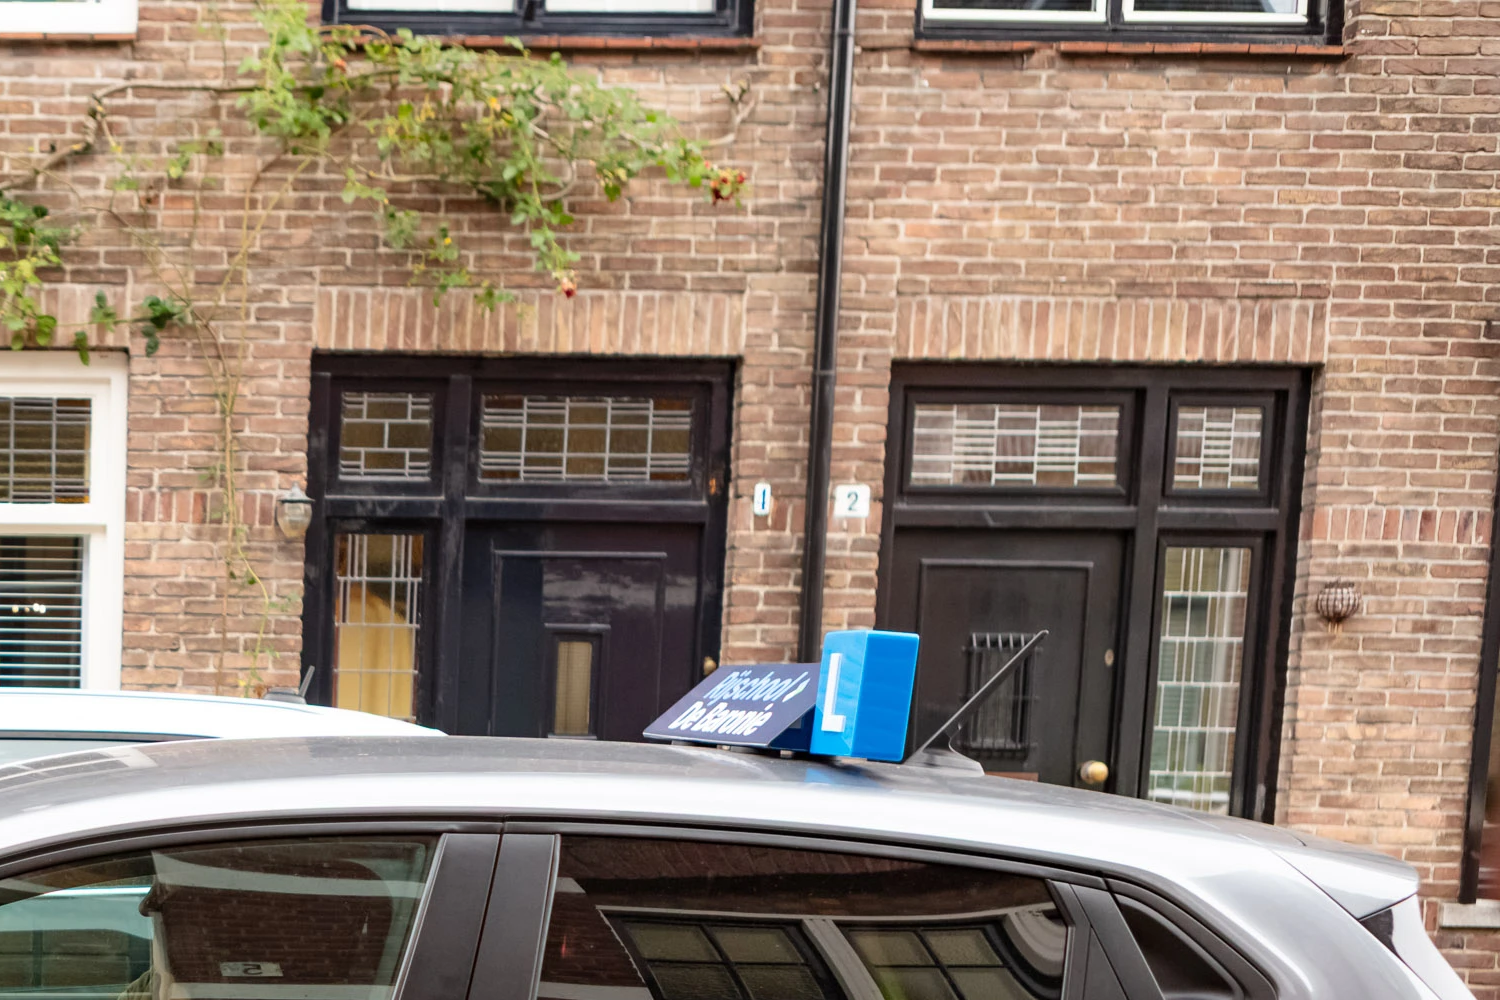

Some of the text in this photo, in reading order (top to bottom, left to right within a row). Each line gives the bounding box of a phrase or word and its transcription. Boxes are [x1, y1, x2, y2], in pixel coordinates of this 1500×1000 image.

[847, 491, 859, 511] 2
[703, 669, 808, 707] Rijschool
[821, 652, 846, 732] L
[667, 700, 774, 736] De Baronie
